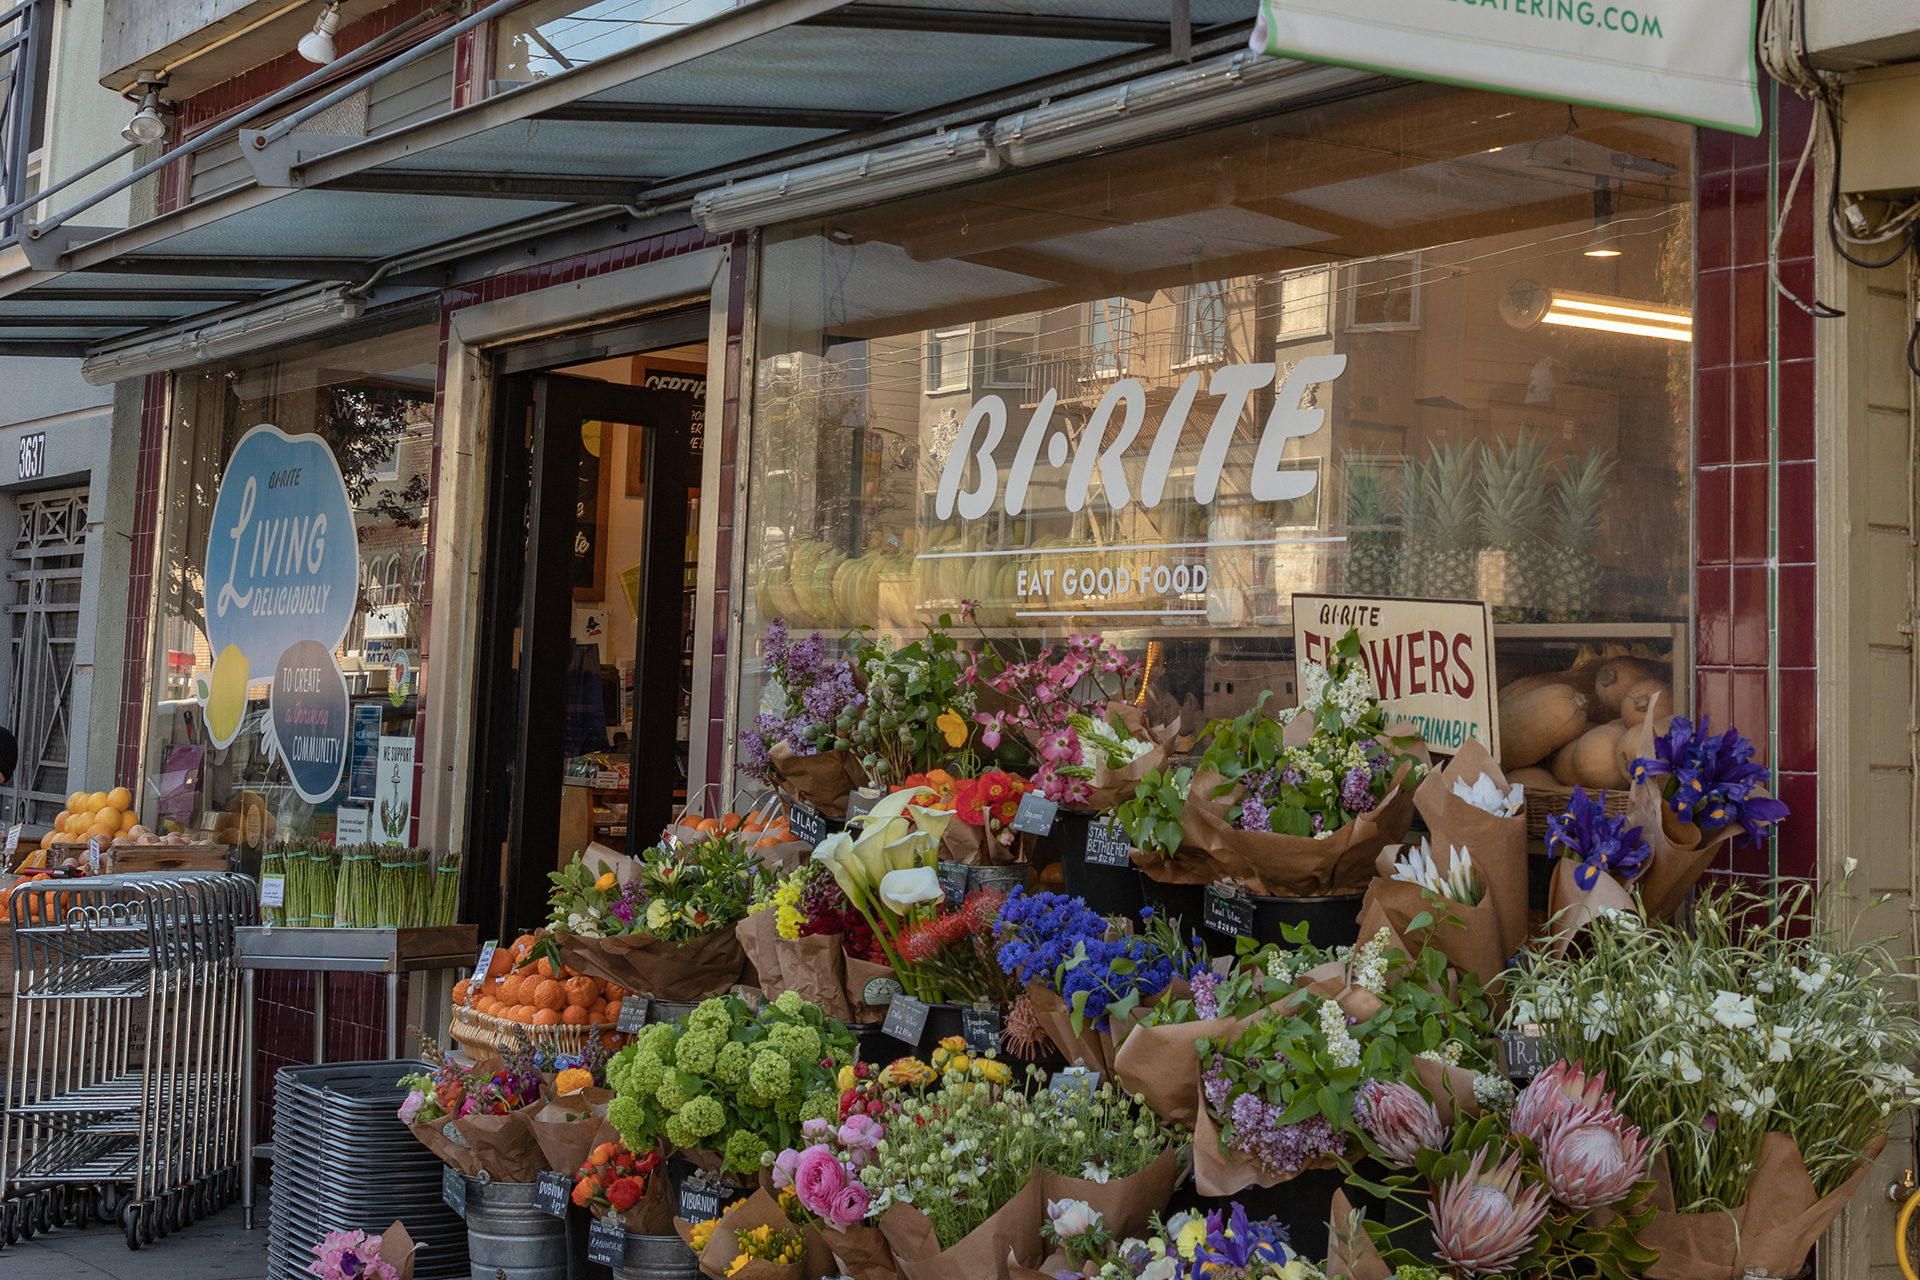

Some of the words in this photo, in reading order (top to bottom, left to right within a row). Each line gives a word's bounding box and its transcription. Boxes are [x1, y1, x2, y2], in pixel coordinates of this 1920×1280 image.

[19, 434, 45, 478] 3637
[1017, 569, 1055, 597] EAT
[1062, 567, 1130, 595] GOOD
[1140, 565, 1208, 593] FOOD
[252, 583, 331, 616] DELICIOUSLY
[282, 668, 293, 693] TO
[294, 668, 322, 693] CREATE
[293, 700, 329, 735] thriving
[292, 735, 341, 764] COMMUNITY
[383, 746, 391, 761] WE
[391, 746, 412, 763] SUPPORT
[790, 807, 818, 834] LILAC
[1088, 826, 1108, 841] STAR
[1111, 828, 1123, 841] OF
[1087, 838, 1130, 858] BETHLEHEM
[1217, 920, 1238, 935] $29.99
[681, 1190, 718, 1216] VIBURNUM
